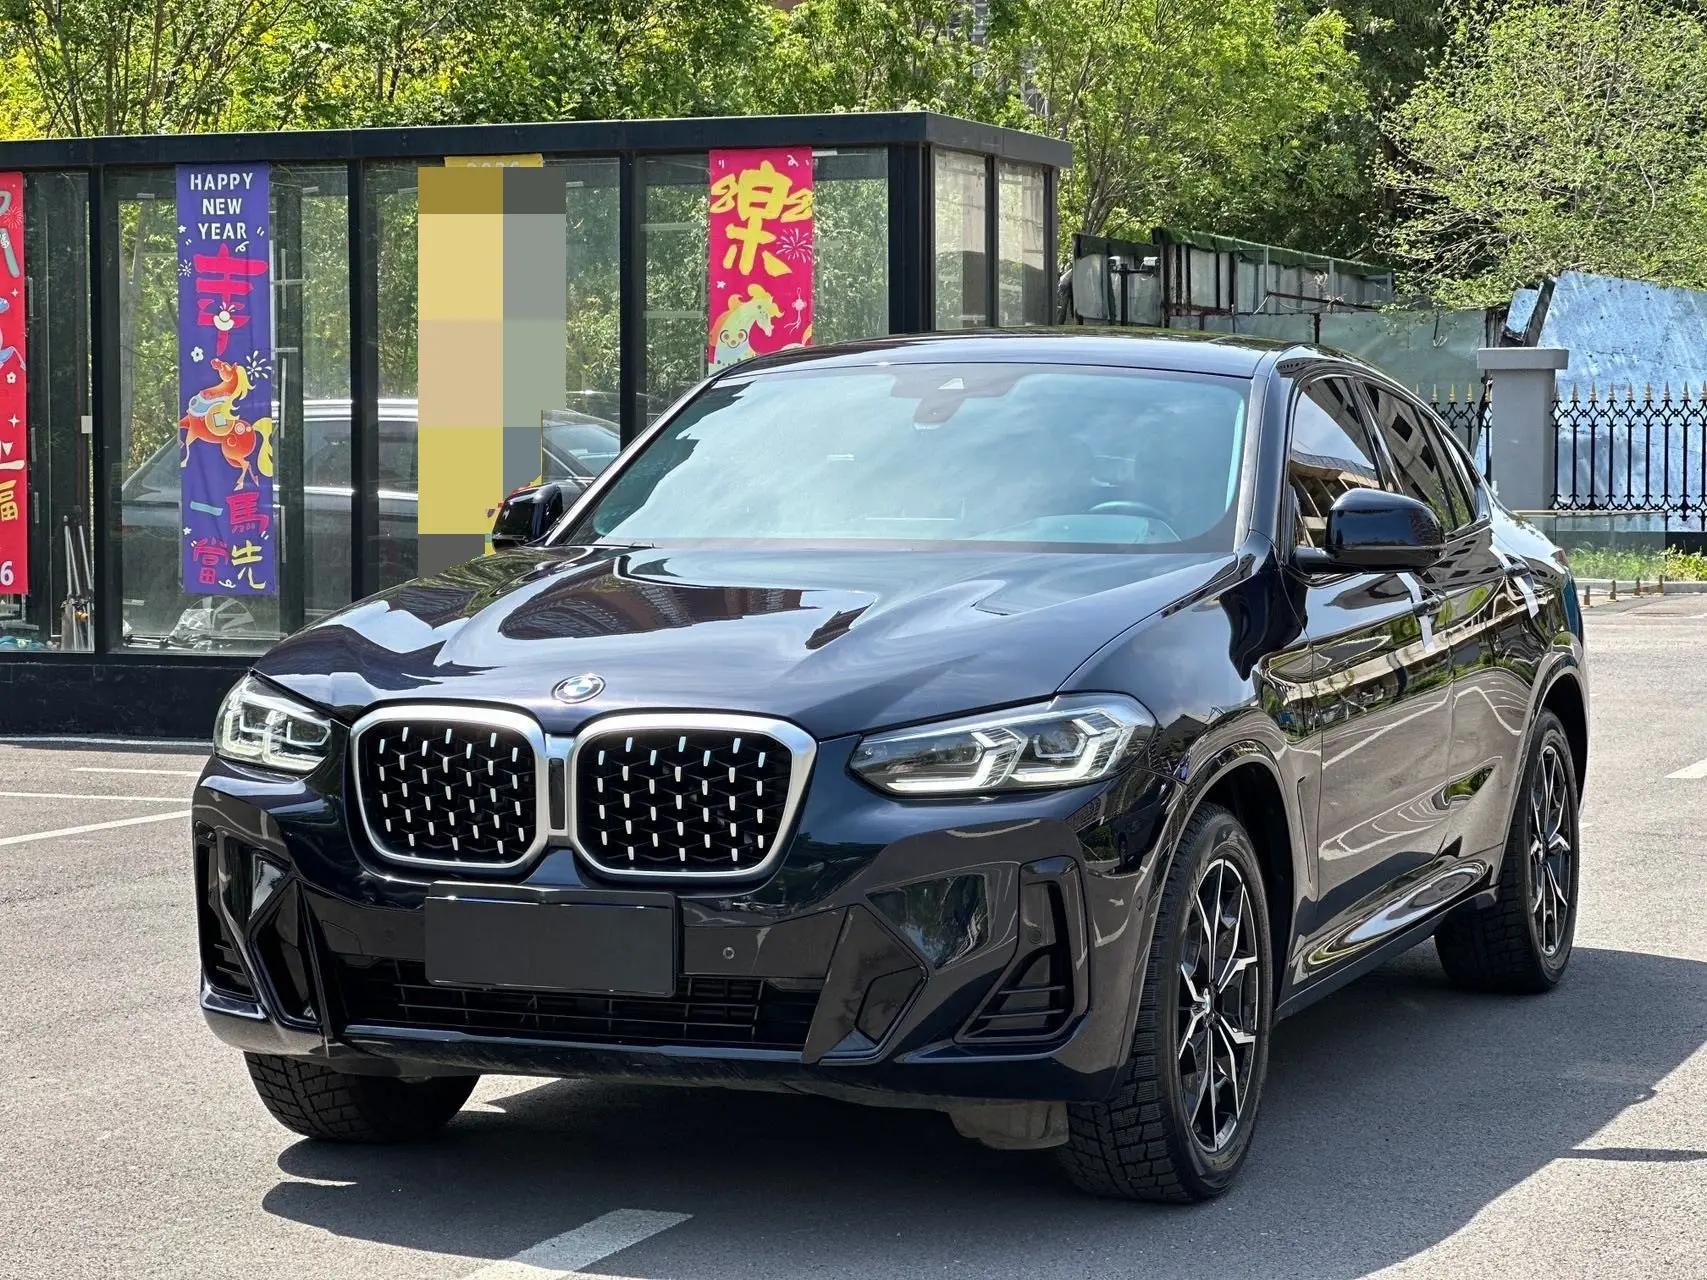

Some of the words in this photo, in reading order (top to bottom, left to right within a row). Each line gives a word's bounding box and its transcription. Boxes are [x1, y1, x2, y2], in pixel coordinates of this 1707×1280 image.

[190, 173, 253, 190] HAPPY
[202, 198, 242, 215] NEW
[198, 222, 247, 240] YEAR
